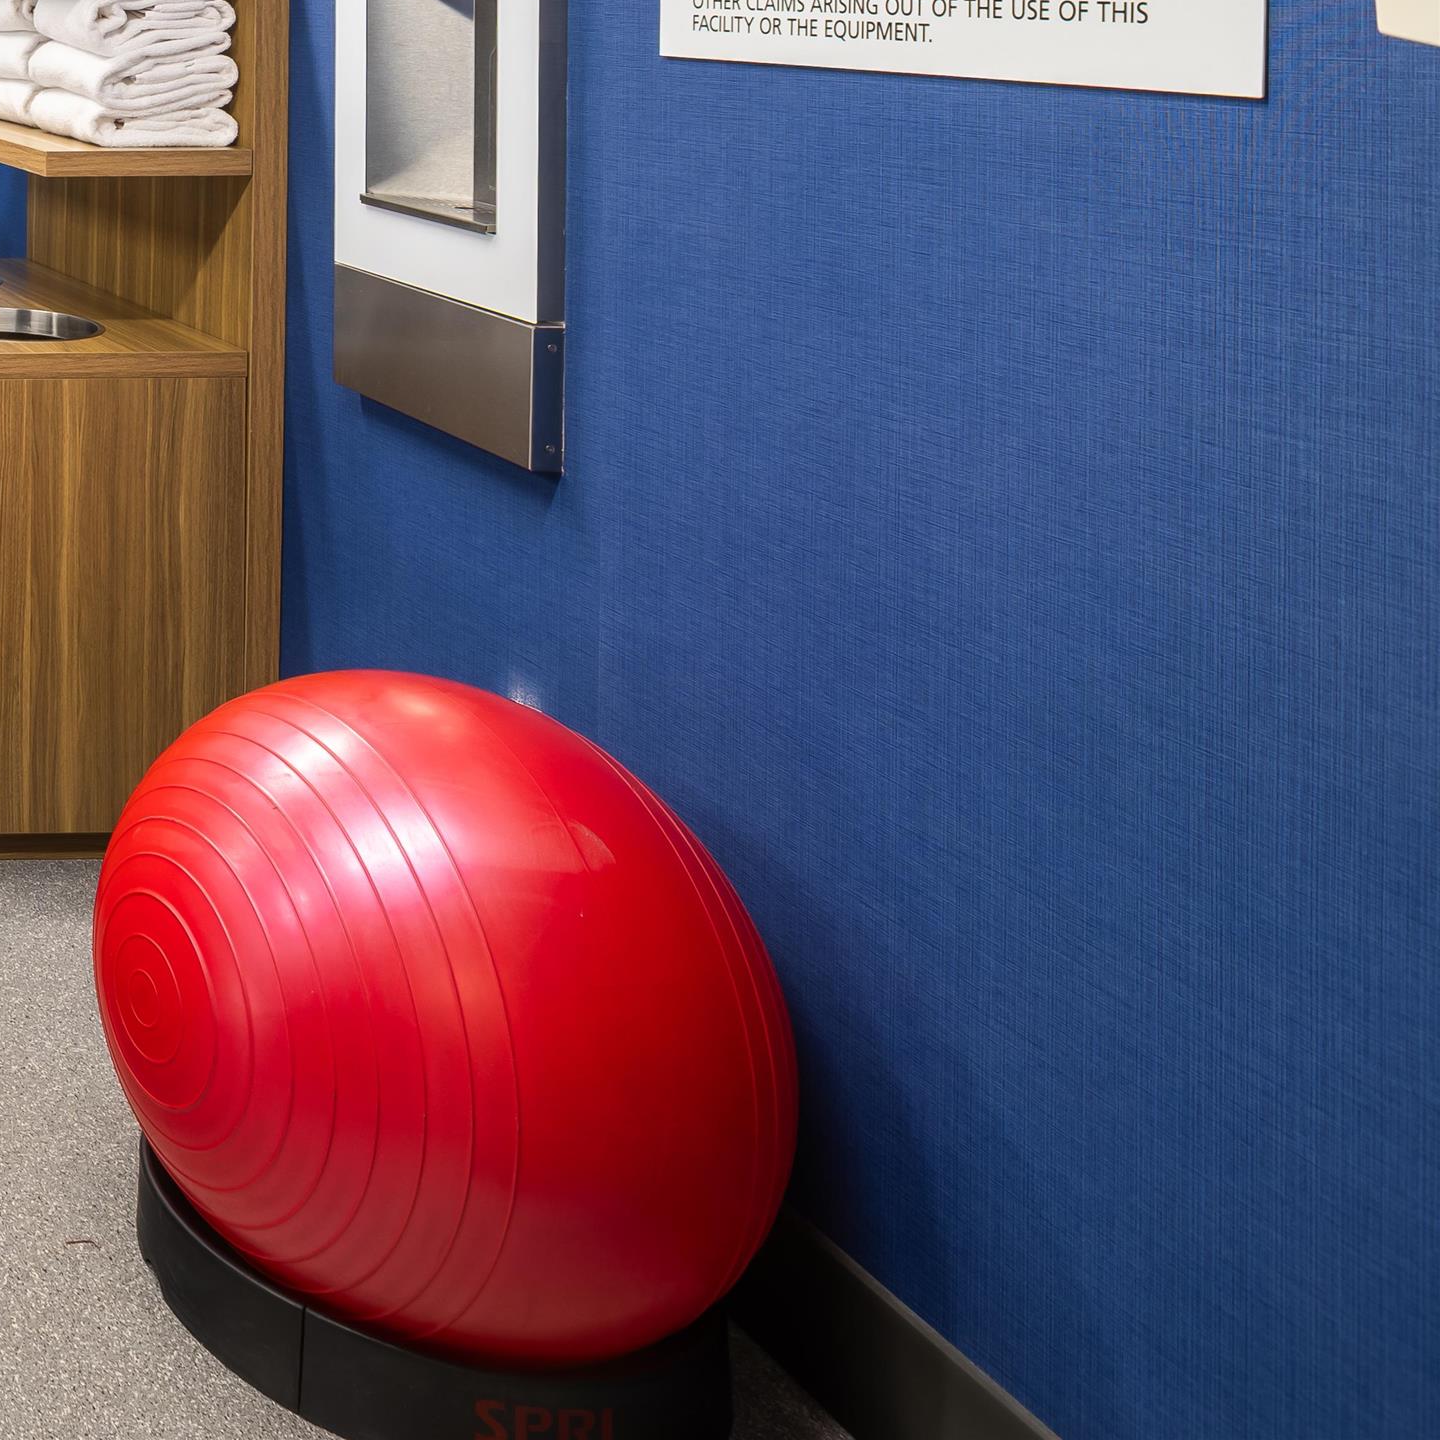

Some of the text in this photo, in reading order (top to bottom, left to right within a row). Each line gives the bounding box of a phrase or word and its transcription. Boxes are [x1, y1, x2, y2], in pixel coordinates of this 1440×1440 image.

[1058, 0, 1089, 22] OF
[1096, 0, 1148, 24] THIS
[692, 13, 932, 43] FACILITY OR THE EQUIPMENT.
[473, 1399, 615, 1440] SPRI
